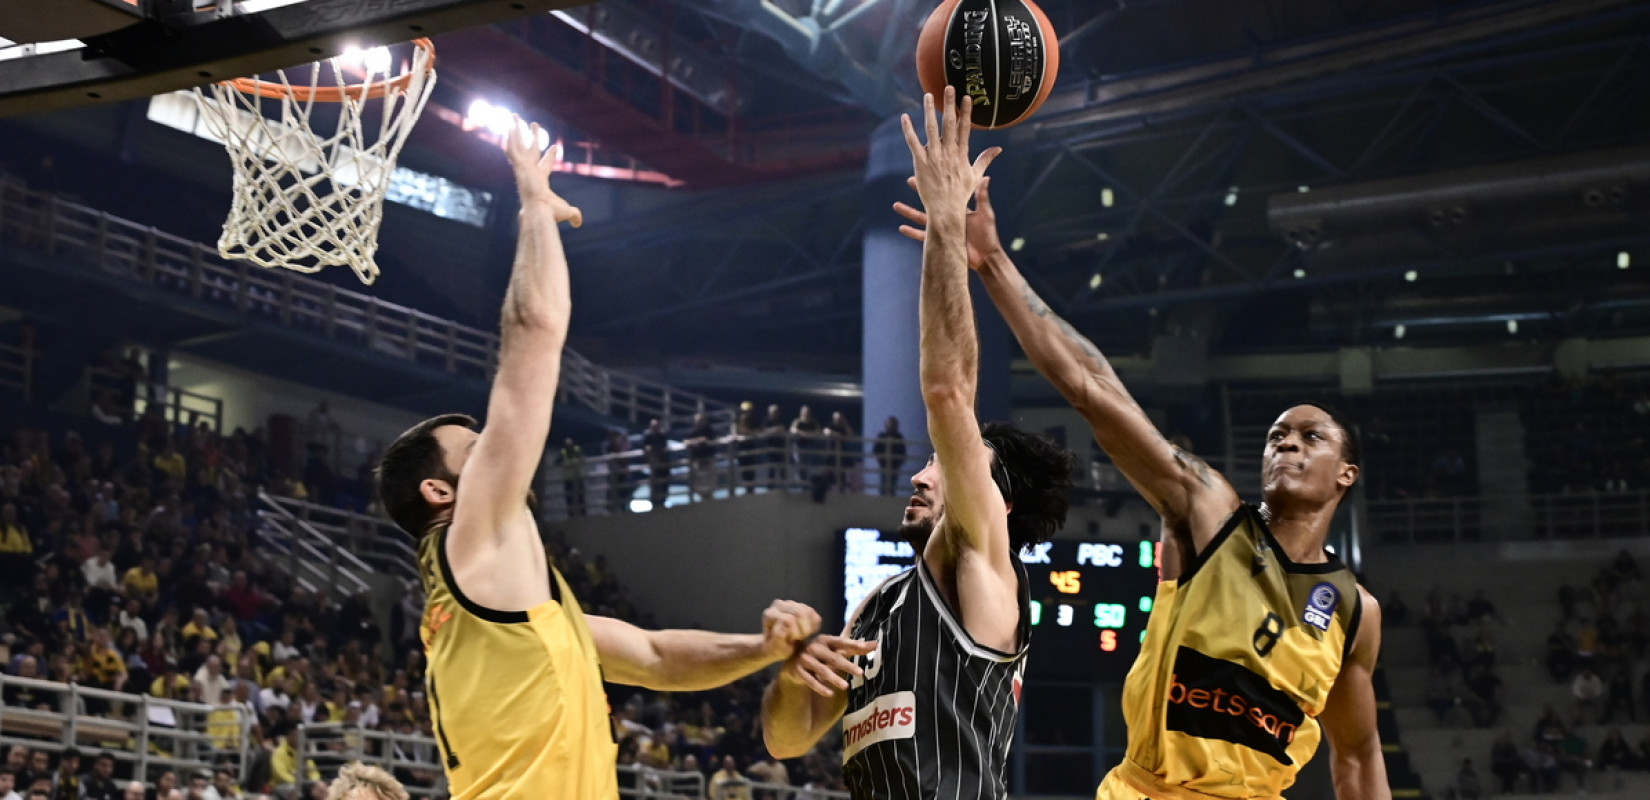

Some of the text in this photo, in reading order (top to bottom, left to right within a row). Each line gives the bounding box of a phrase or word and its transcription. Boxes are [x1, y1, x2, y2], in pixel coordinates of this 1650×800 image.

[963, 8, 990, 106] SPALDING
[1077, 543, 1123, 567] PBC
[1050, 570, 1081, 594] 45
[1094, 603, 1127, 628] 50
[1304, 612, 1327, 629] GBL
[1253, 611, 1285, 657] 8
